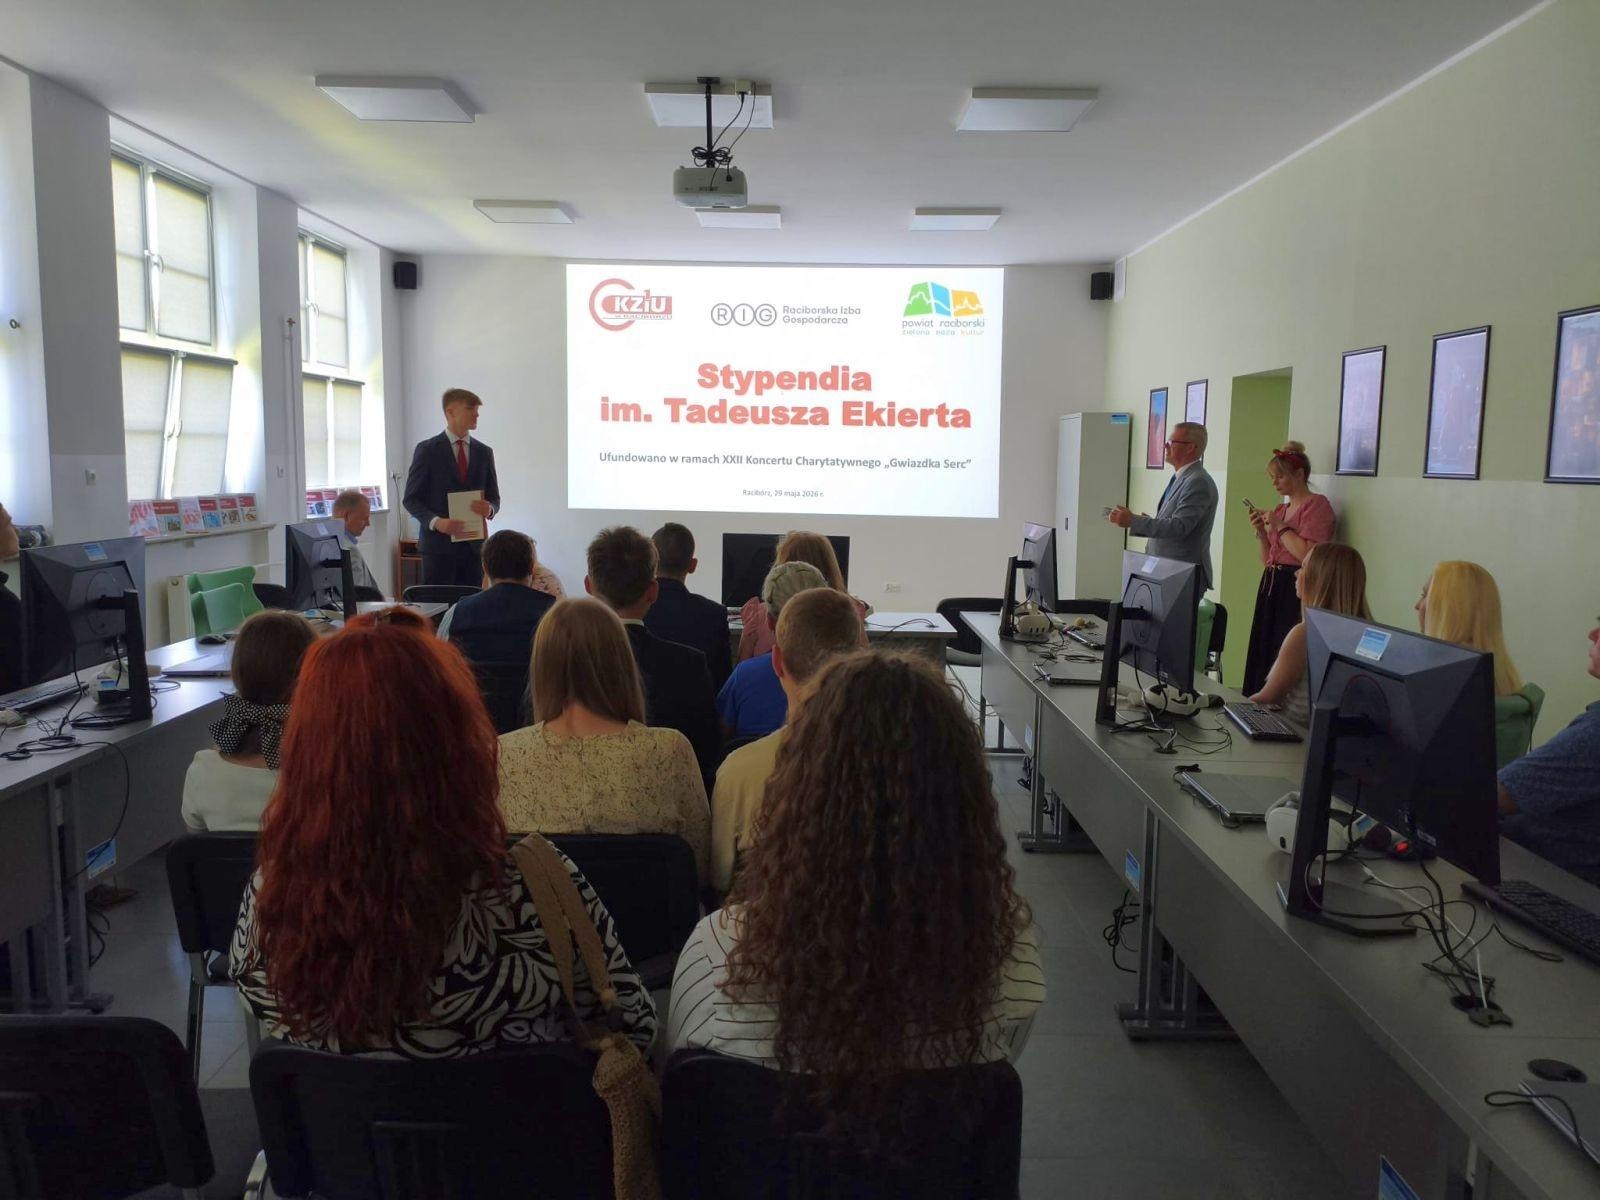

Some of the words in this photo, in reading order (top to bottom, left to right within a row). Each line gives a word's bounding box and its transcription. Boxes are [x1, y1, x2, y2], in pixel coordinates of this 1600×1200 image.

[714, 305, 774, 324] RIG
[782, 305, 838, 315] Raciborska
[840, 306, 861, 315] Izba
[782, 315, 848, 325] Gospodarcza
[901, 319, 934, 329] powiat
[939, 318, 985, 328] raciborski
[697, 363, 873, 396] Stypendia
[600, 397, 653, 422] im.
[664, 398, 830, 426] Tadeusza
[841, 400, 972, 429] Ekierta
[599, 452, 667, 463] Ufundowano
[669, 455, 679, 463] w
[681, 454, 720, 464] ramach
[722, 455, 743, 465] XXII
[745, 455, 793, 466] Koncertu
[795, 455, 882, 470] Charytatywnego
[884, 458, 941, 469] „Gwiazdka
[943, 458, 972, 469] Serc”
[742, 489, 773, 497] Racibórz,
[774, 489, 783, 497] 29
[784, 490, 801, 498] maja
